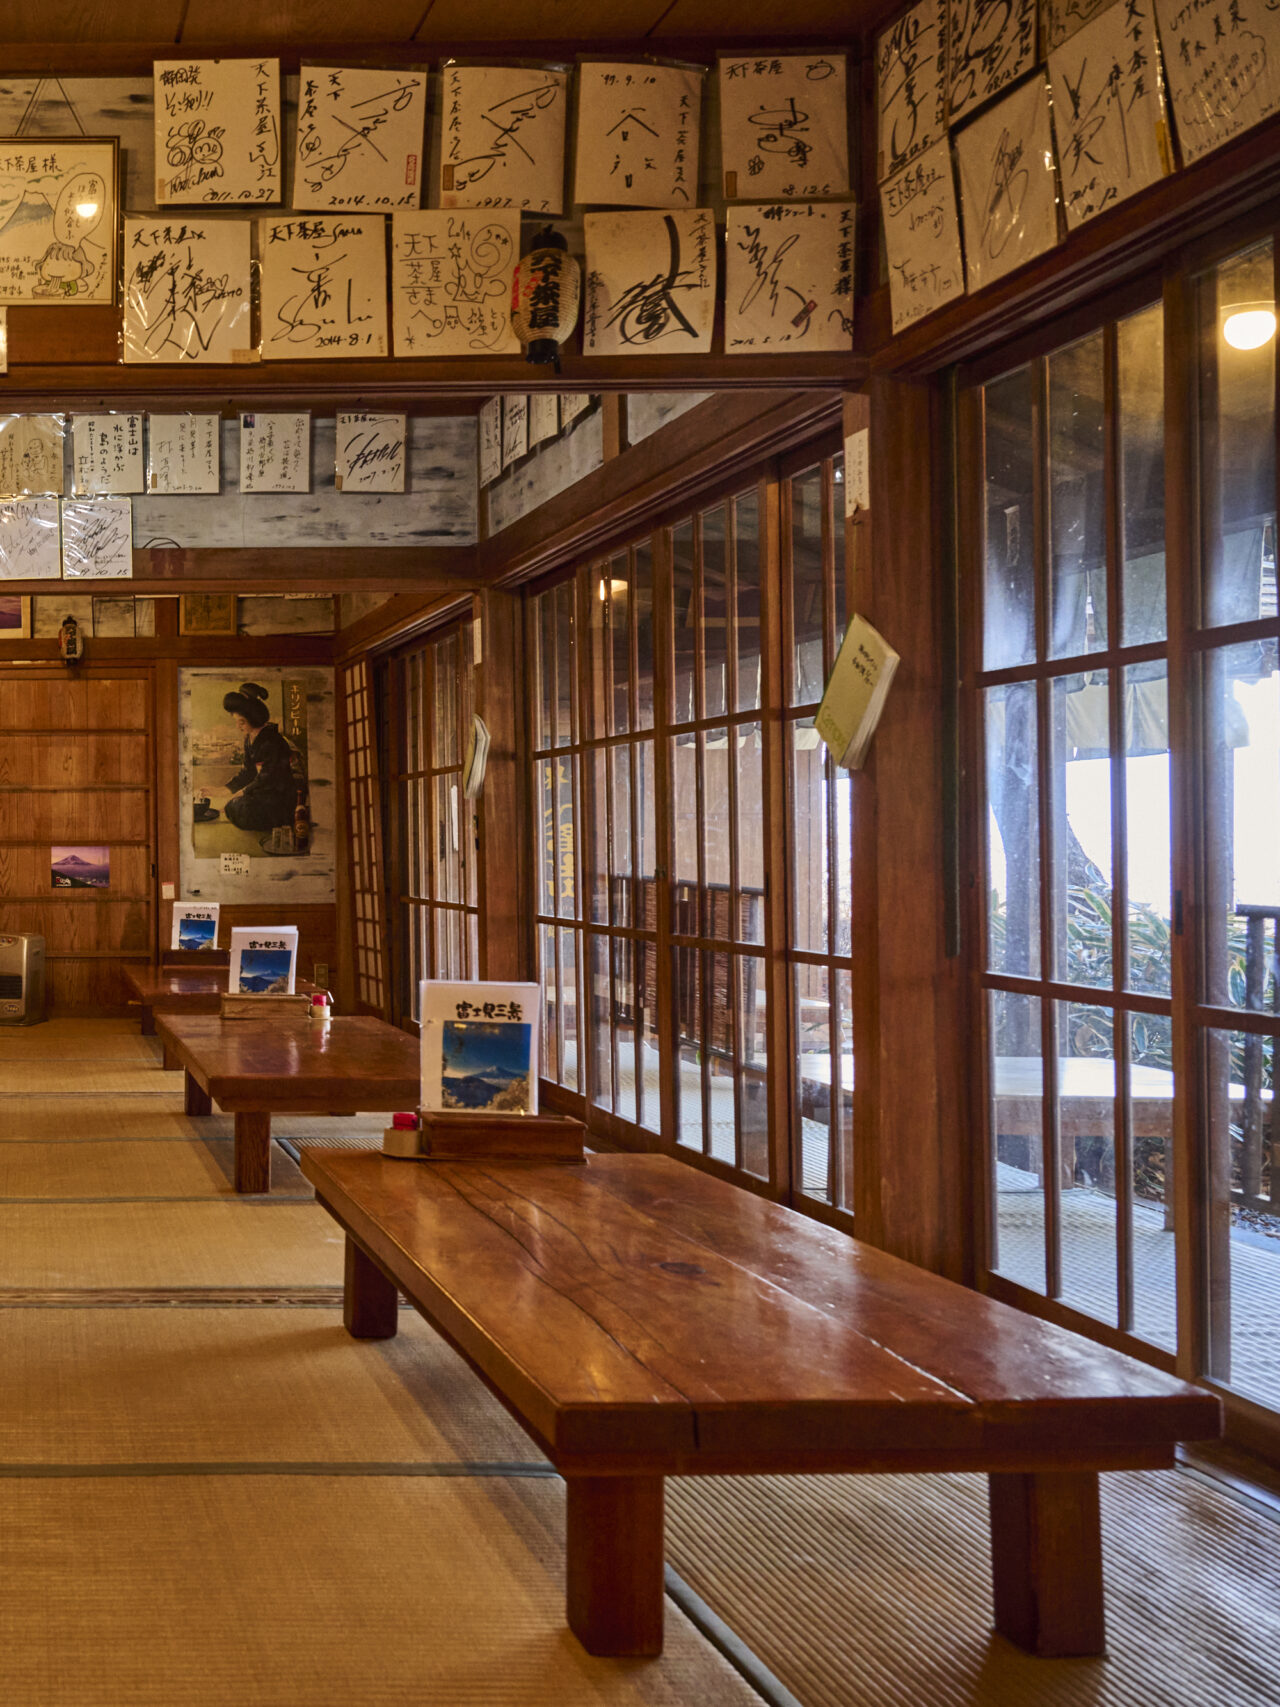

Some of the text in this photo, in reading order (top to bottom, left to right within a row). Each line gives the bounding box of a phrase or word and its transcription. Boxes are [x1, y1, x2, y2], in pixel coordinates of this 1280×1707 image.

[290, 684, 301, 737] キリンビール
[456, 1000, 524, 1021] 富士見三景
